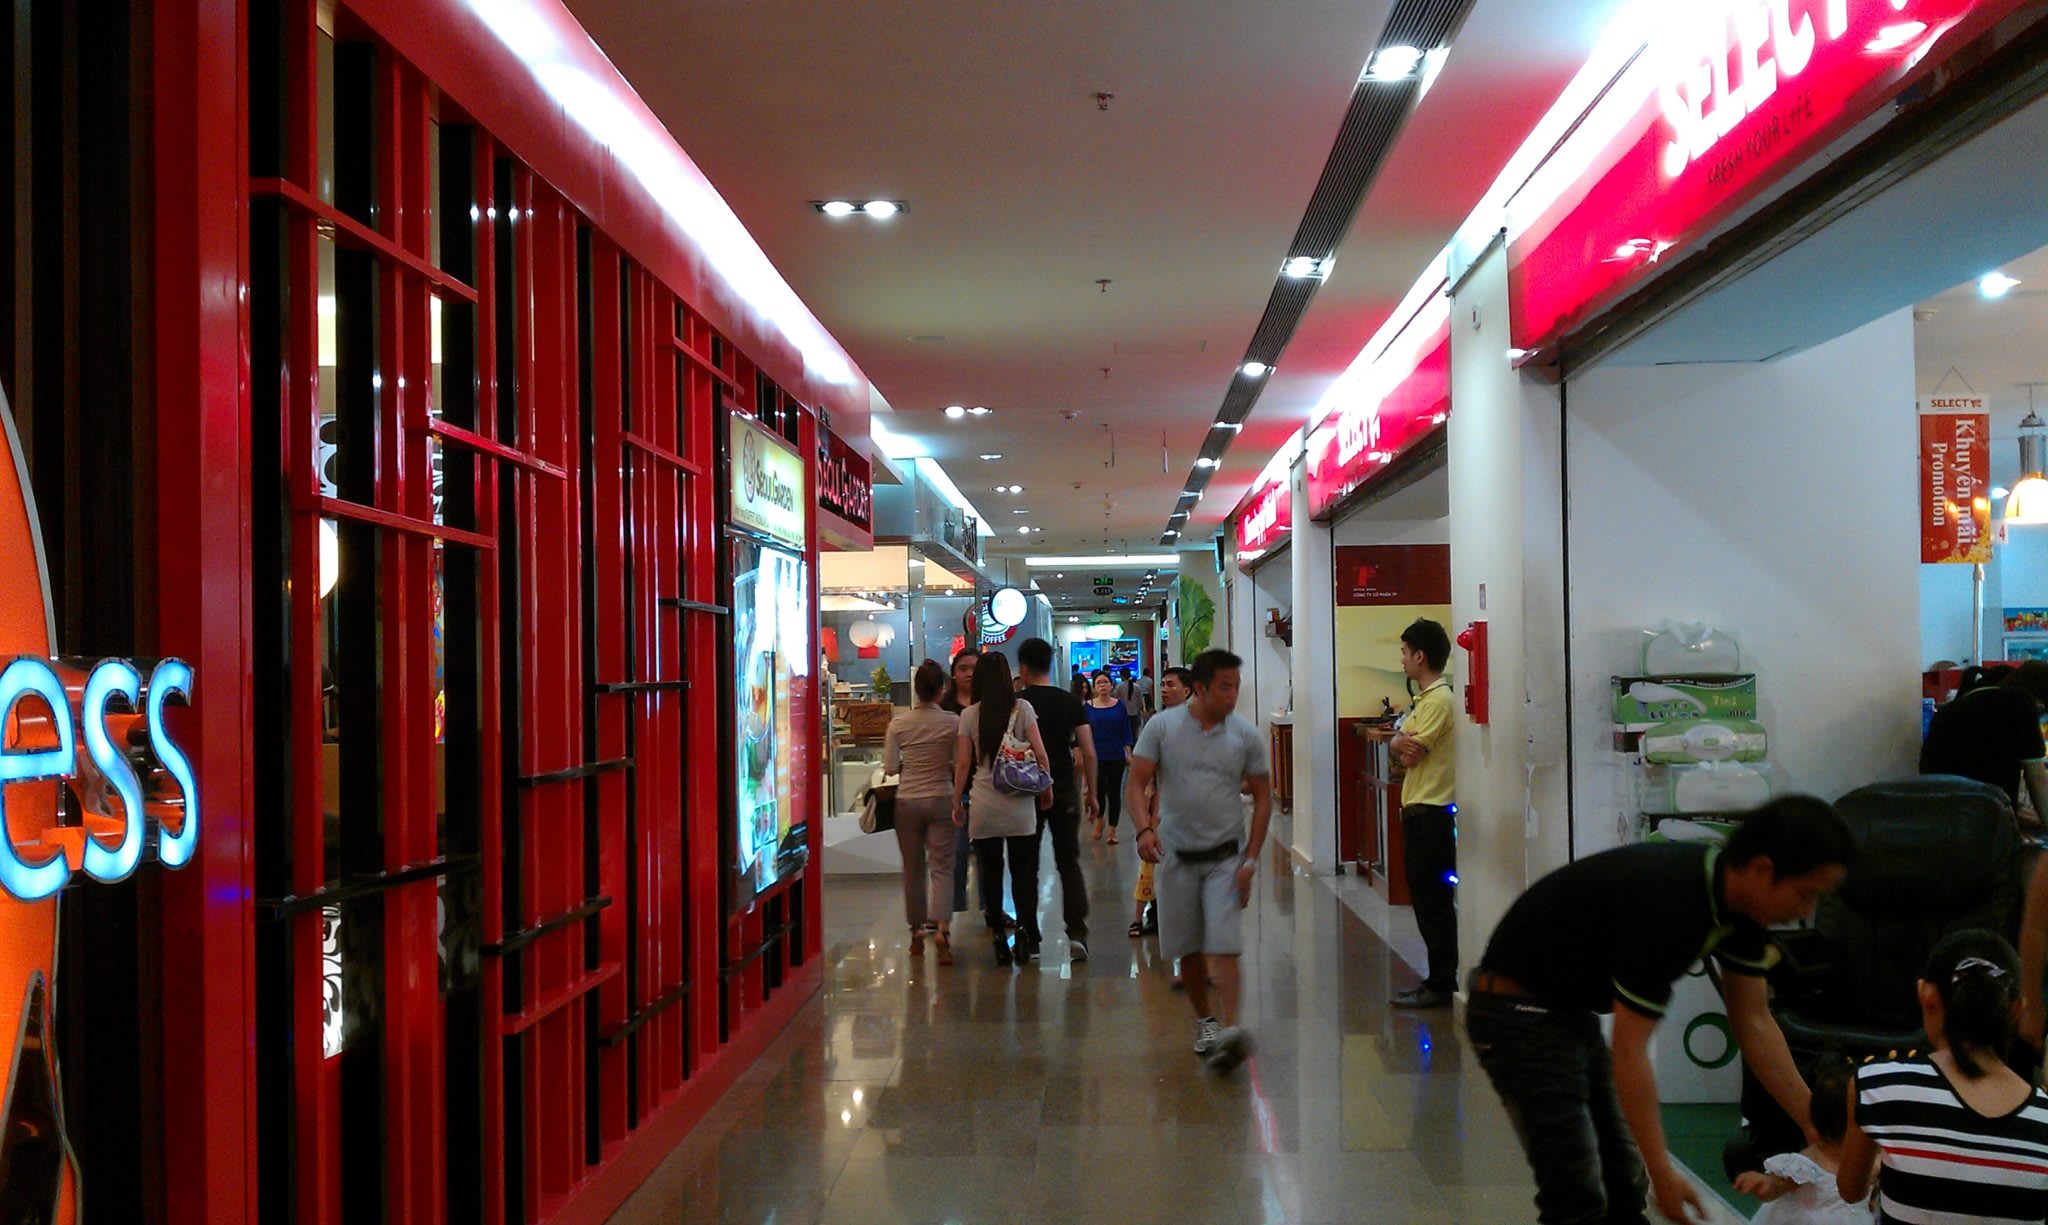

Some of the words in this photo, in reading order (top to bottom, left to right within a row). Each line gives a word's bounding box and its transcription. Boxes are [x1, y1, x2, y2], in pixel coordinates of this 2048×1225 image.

[1932, 442, 1948, 527] Promotion
[1951, 418, 1982, 499] Khuyến
[1956, 505, 1977, 544] mãi
